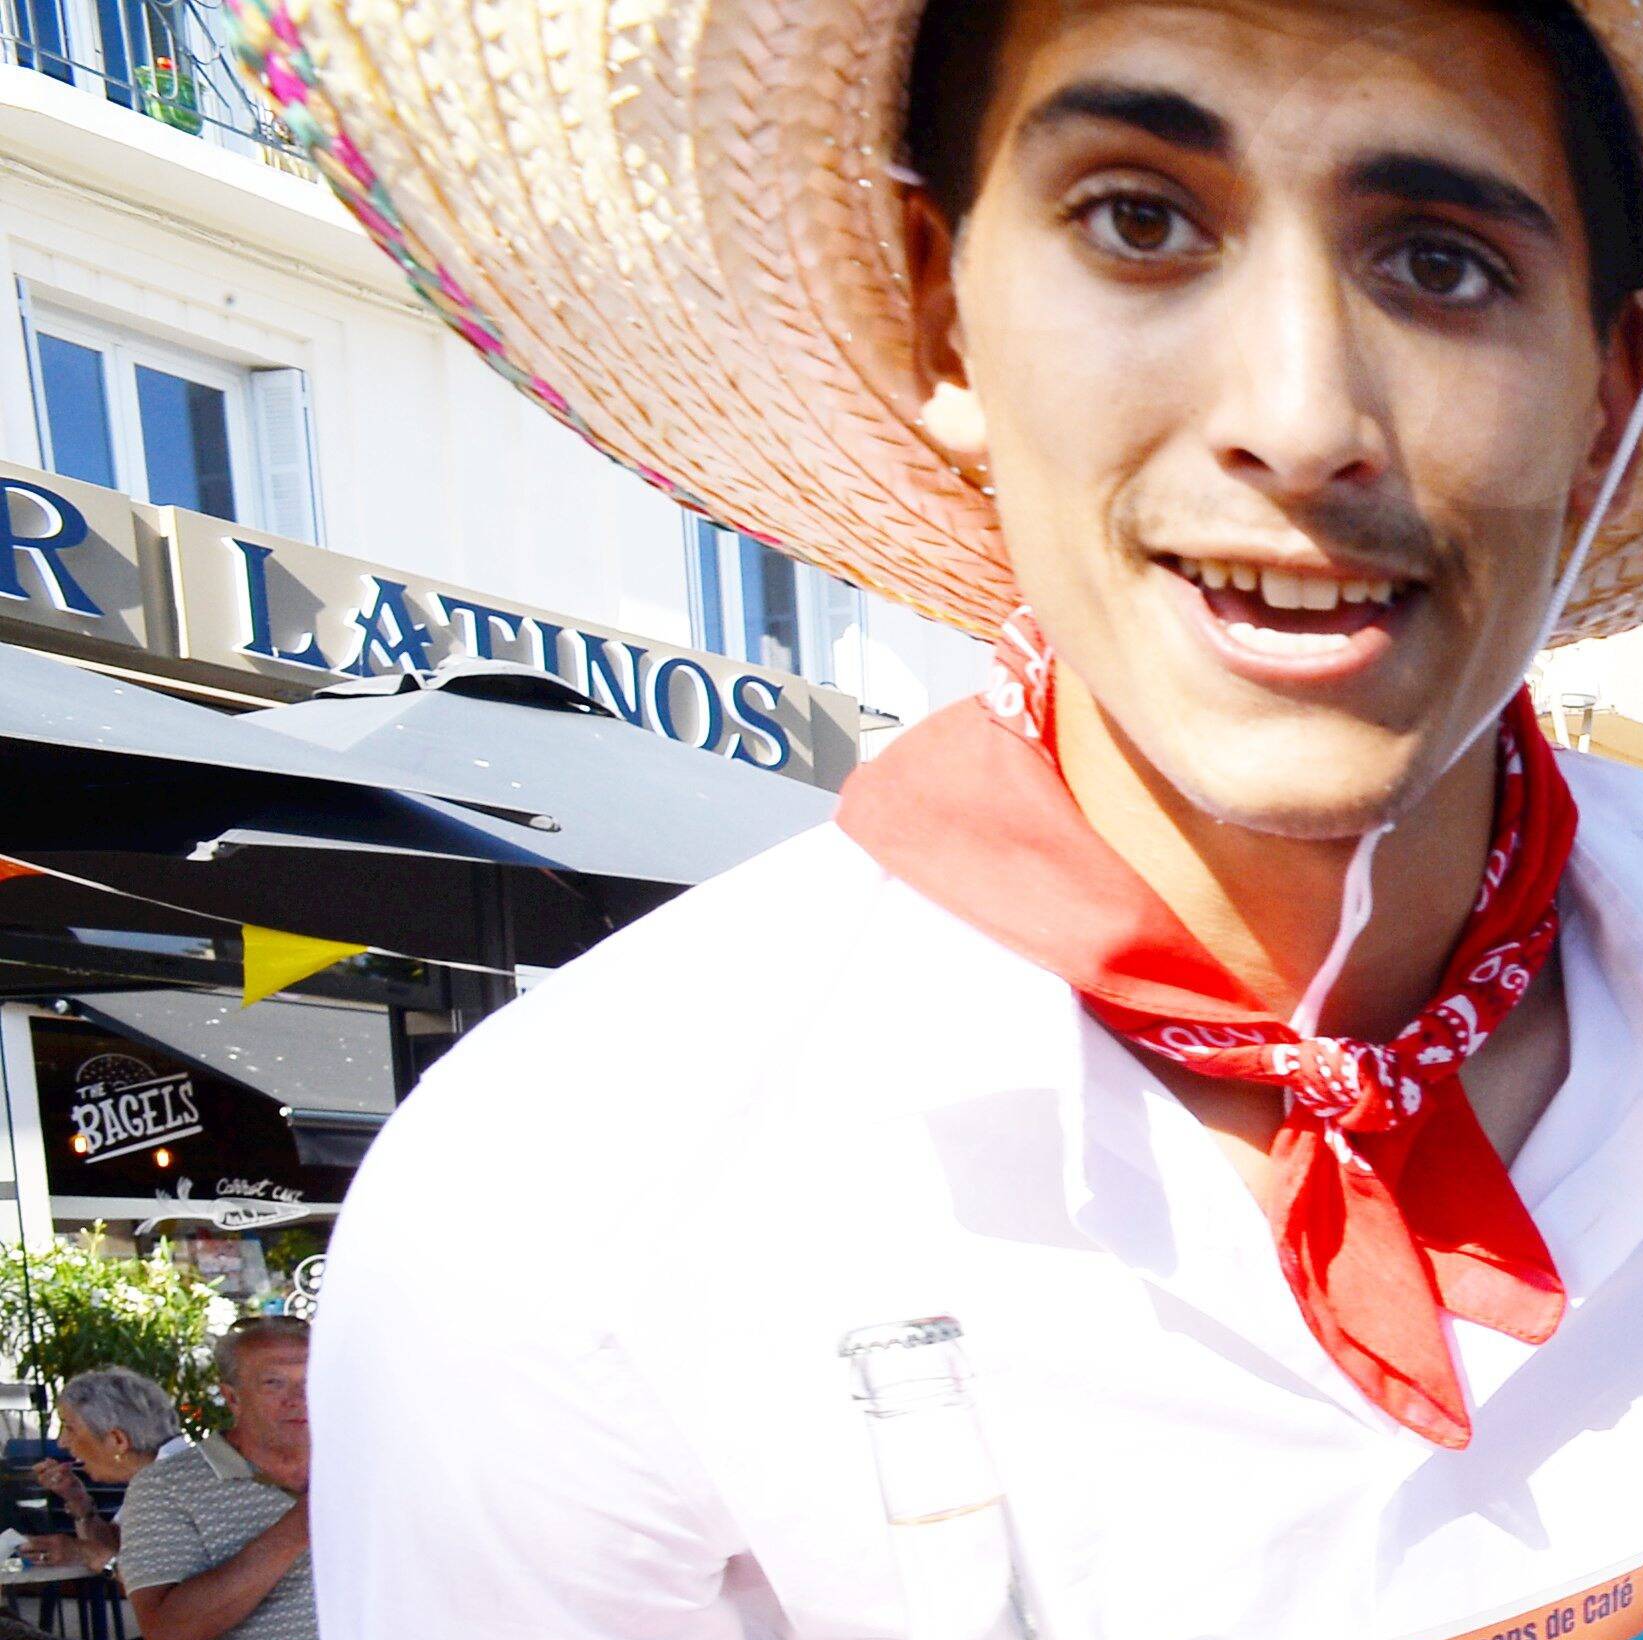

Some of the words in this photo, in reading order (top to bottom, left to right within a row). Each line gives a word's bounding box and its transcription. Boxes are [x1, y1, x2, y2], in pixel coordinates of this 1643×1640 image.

[71, 1081, 200, 1154] BAGELS
[76, 1082, 106, 1098] THE
[1546, 1607, 1575, 1640] de
[1583, 1577, 1635, 1625] Café
